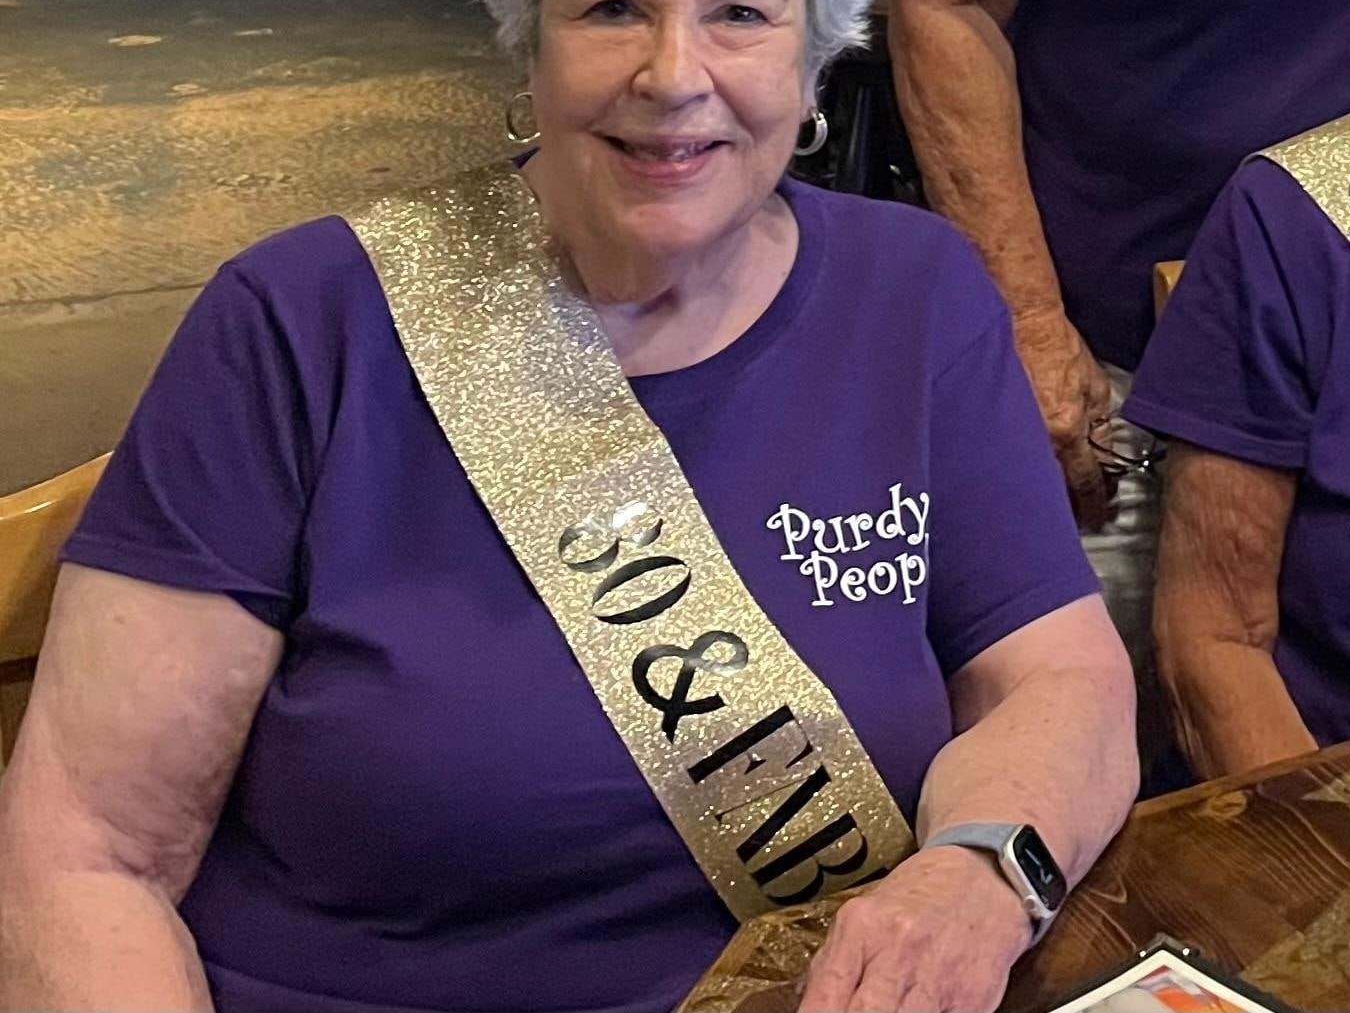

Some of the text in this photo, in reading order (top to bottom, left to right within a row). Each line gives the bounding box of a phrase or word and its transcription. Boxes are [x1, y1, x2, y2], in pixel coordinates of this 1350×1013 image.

[557, 499, 890, 907] 80 & FAB
